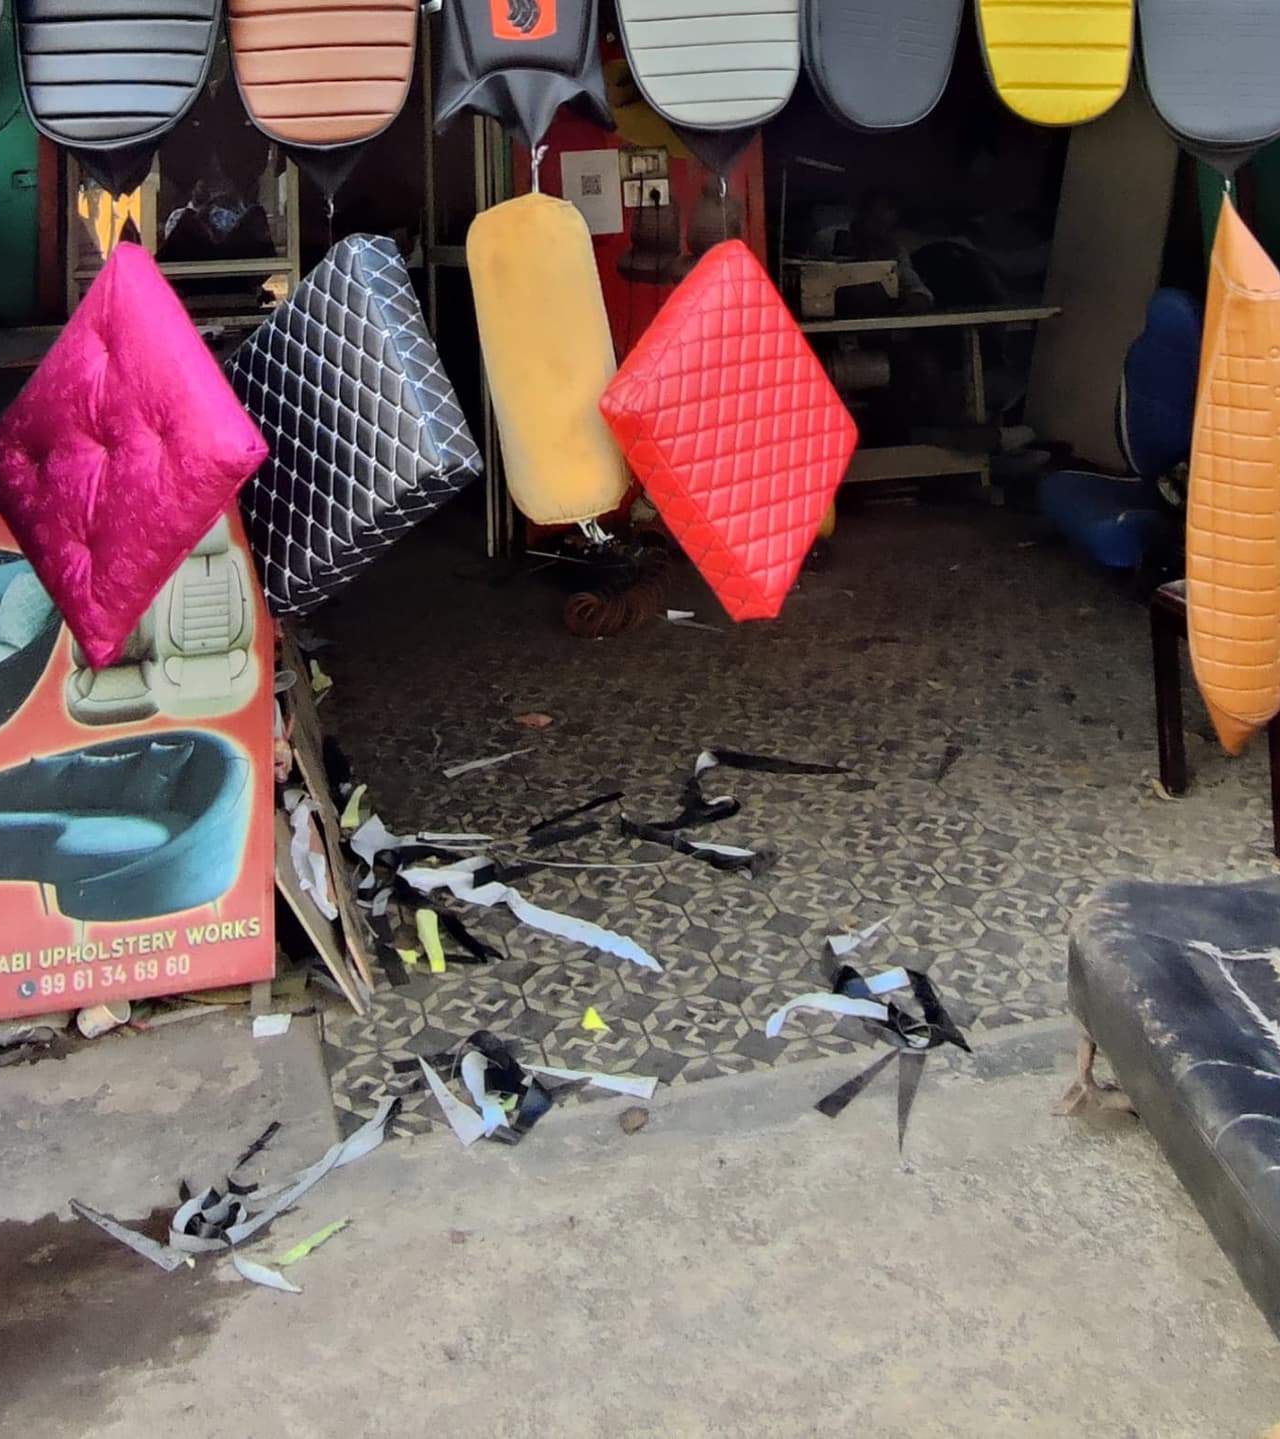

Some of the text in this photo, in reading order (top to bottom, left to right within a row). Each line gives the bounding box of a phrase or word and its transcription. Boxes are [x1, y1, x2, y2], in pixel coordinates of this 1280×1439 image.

[39, 930, 178, 969] UPHOLSTERY
[185, 916, 262, 947] WORKS
[41, 954, 191, 996] 99 61 34 69 60
